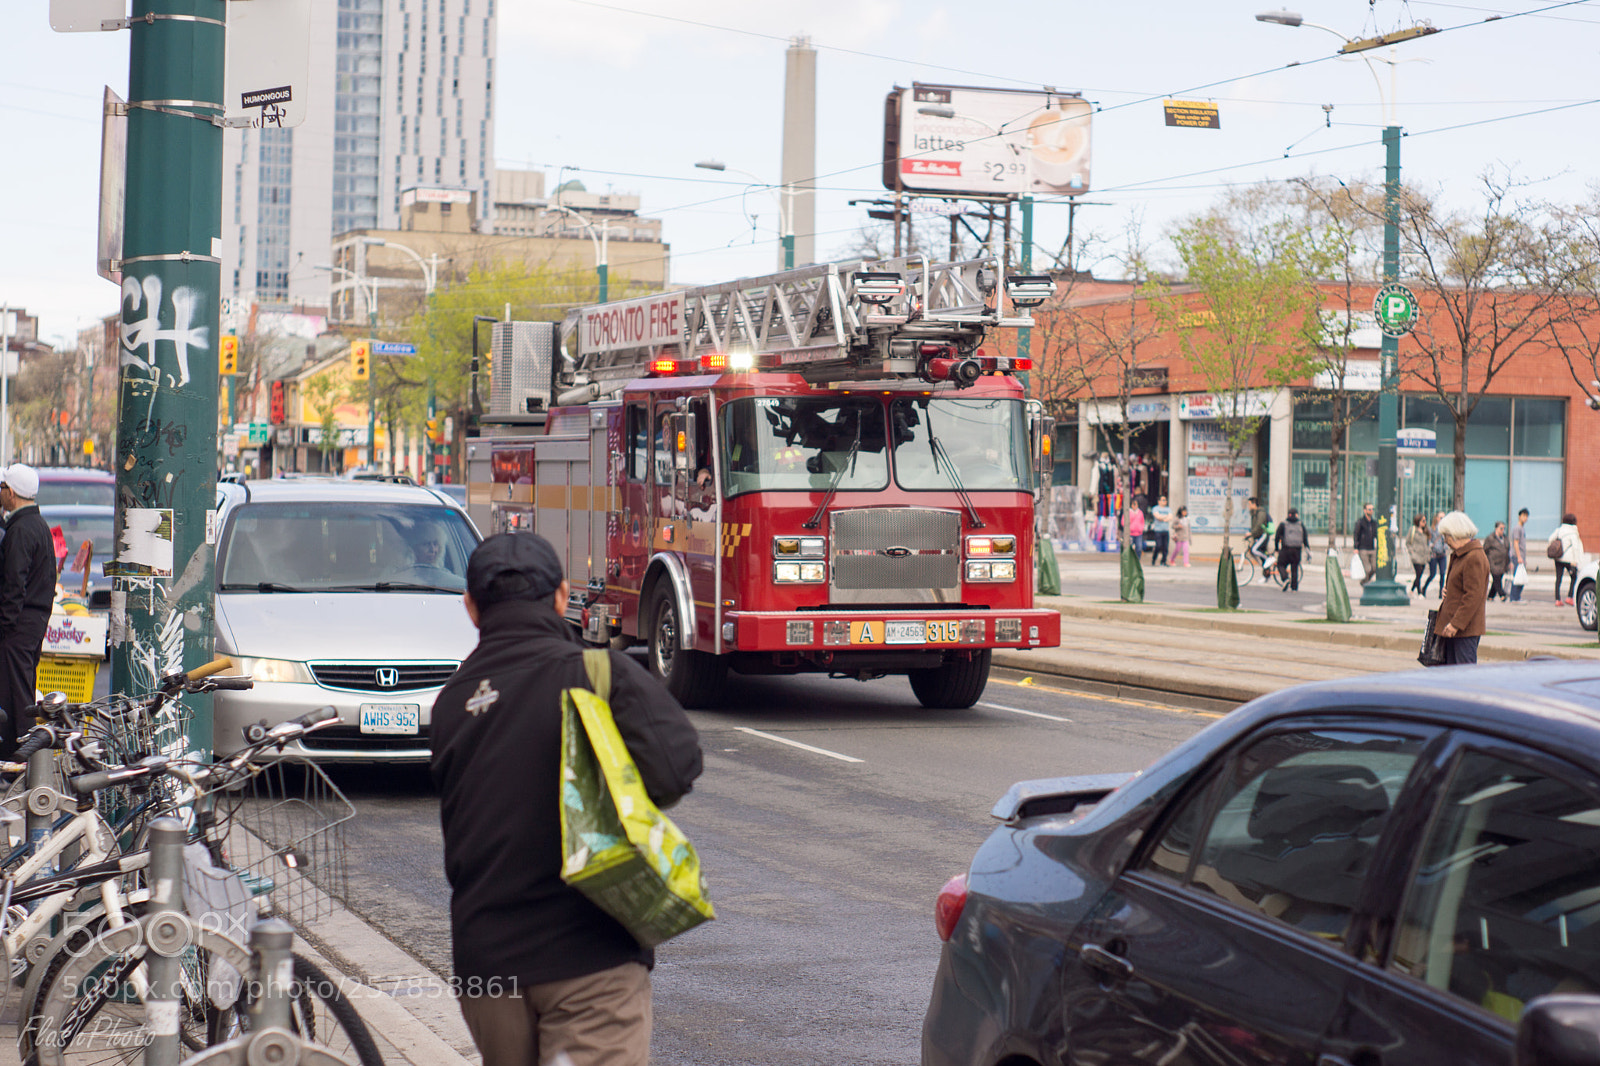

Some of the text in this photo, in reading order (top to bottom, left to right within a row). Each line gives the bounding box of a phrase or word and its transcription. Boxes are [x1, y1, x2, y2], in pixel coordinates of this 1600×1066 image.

[244, 90, 290, 105] HUMONGOUS
[914, 134, 966, 153] lattes
[587, 299, 678, 347] TORONTO FIRE
[859, 621, 874, 643] A
[928, 621, 958, 642] 315
[363, 712, 417, 727] AWHS 952
